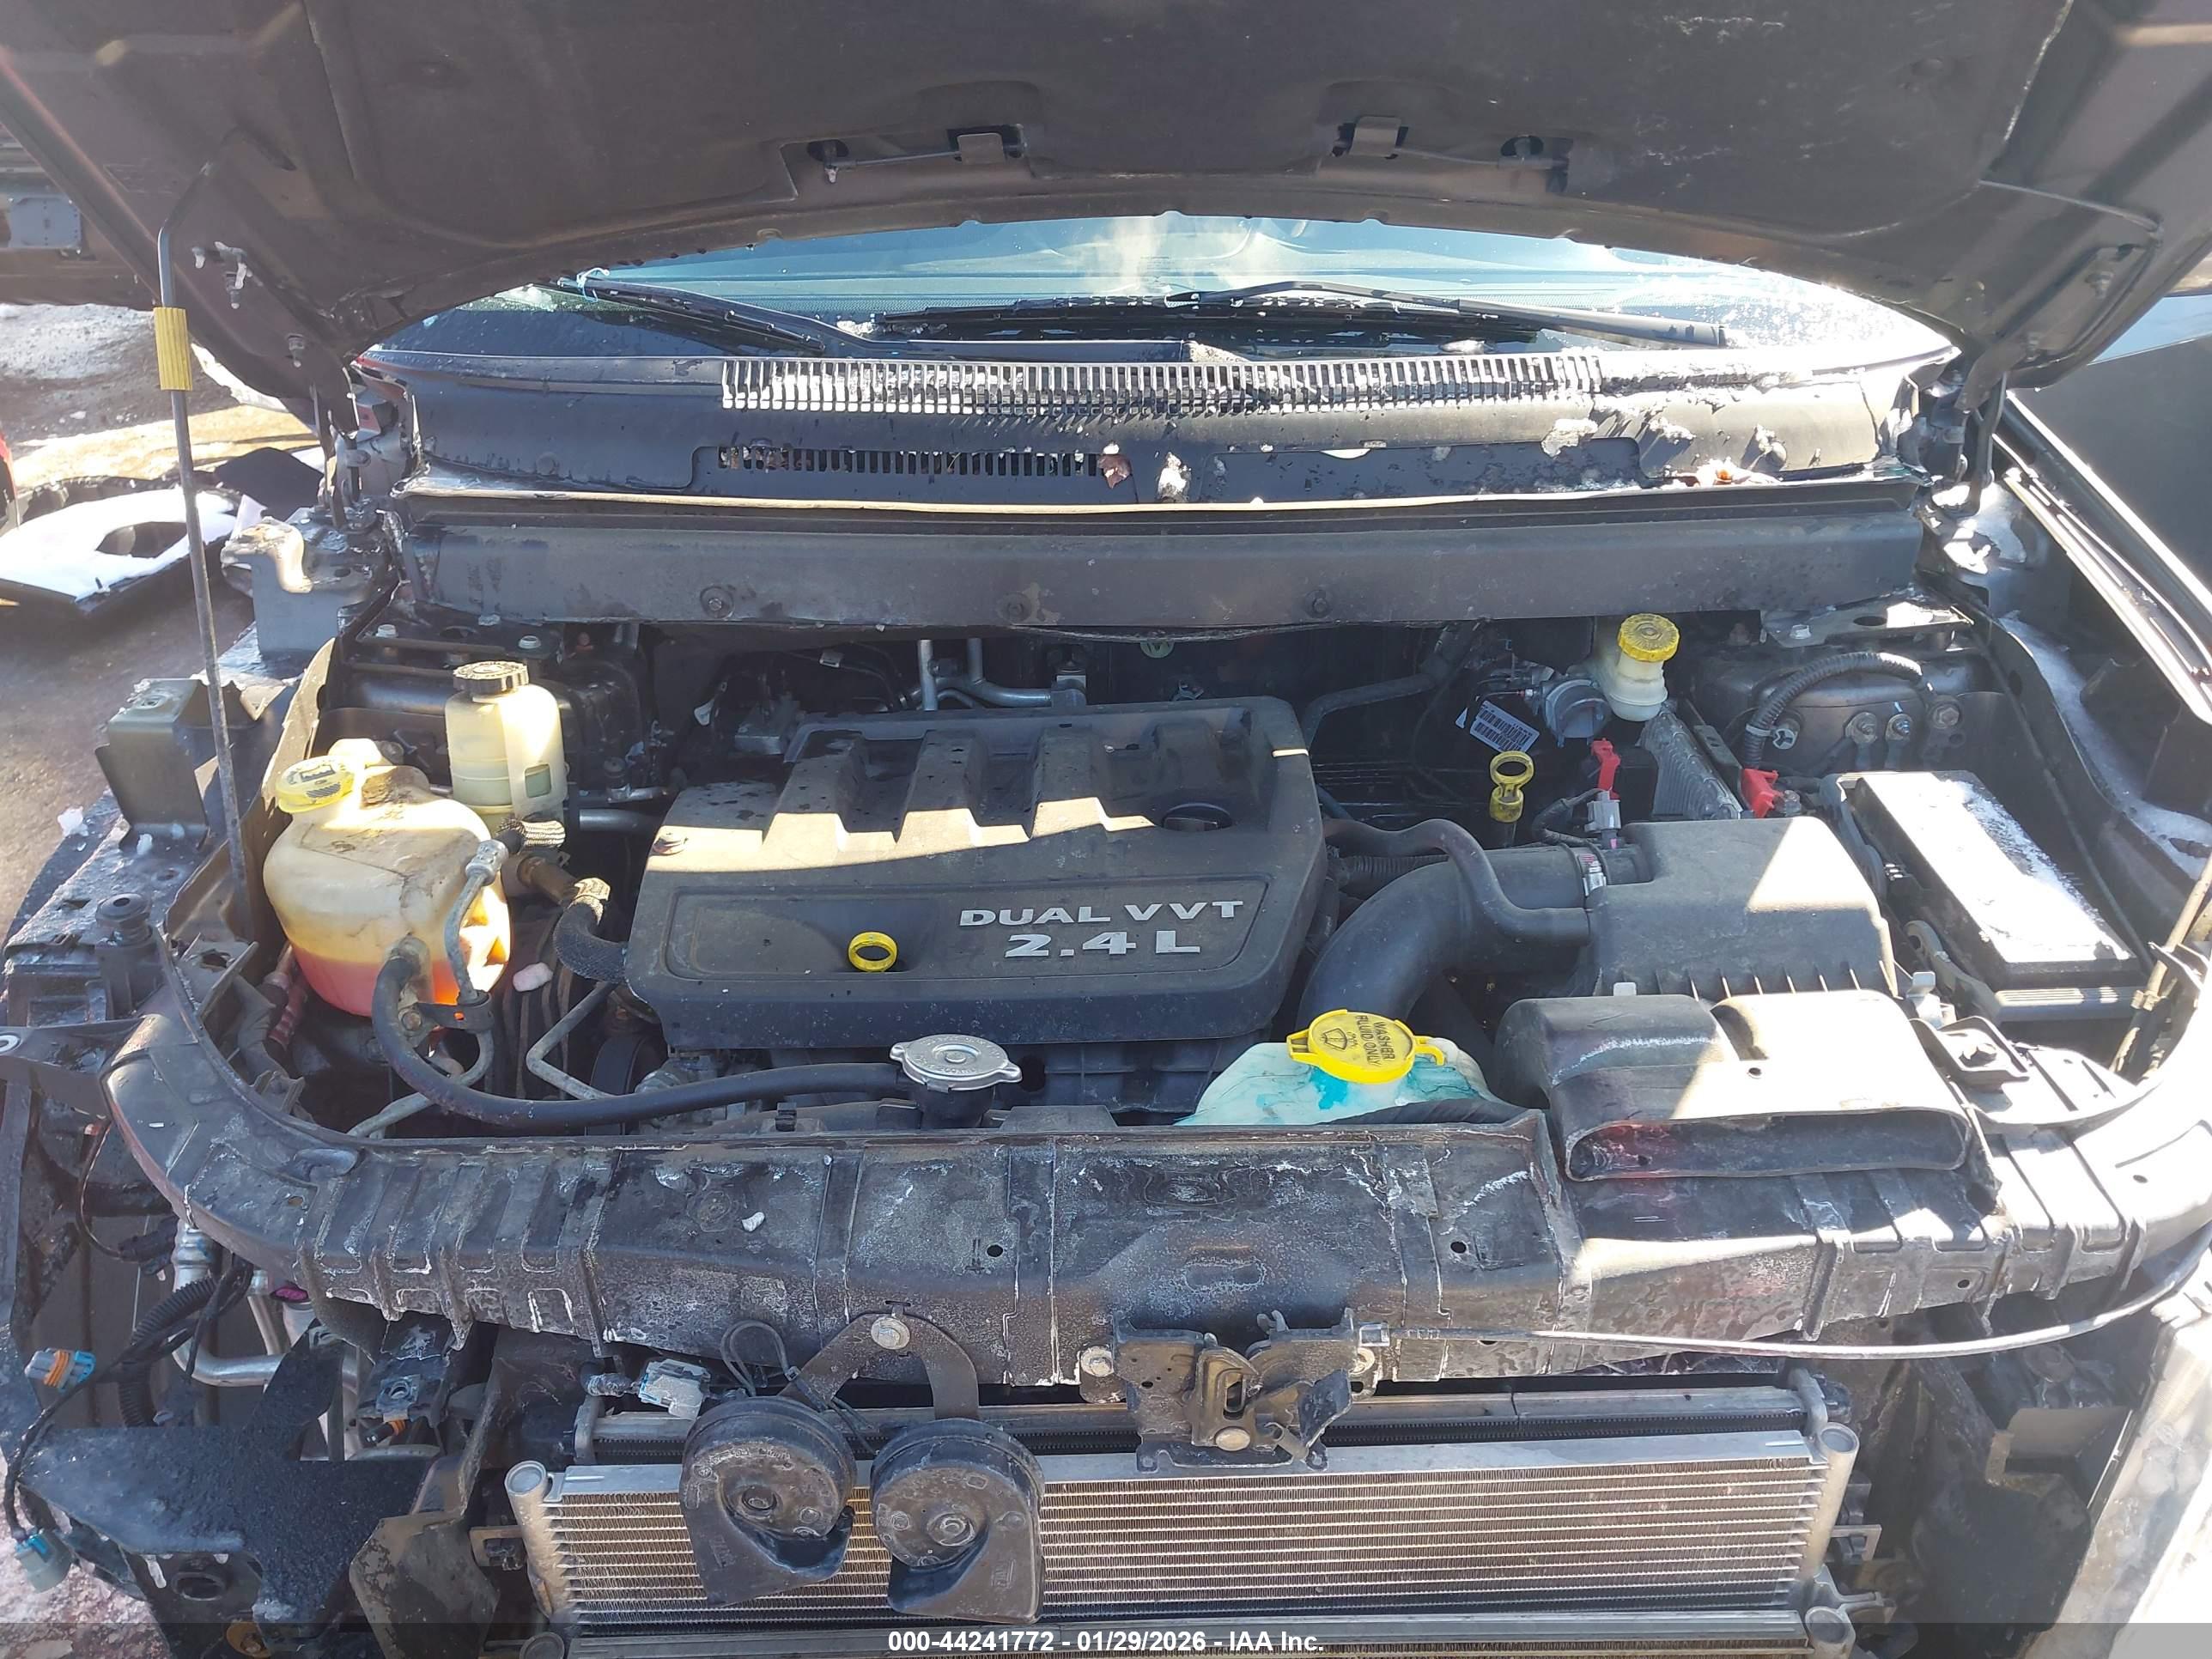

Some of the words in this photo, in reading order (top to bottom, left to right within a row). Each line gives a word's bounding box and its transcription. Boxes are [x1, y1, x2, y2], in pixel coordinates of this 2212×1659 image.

[959, 906, 1111, 927] DUAL
[1124, 901, 1243, 921] VVT
[1355, 1015, 1375, 1043] FLUID
[1373, 1021, 1395, 1060] WASHER
[1363, 1043, 1382, 1066] ONLY
